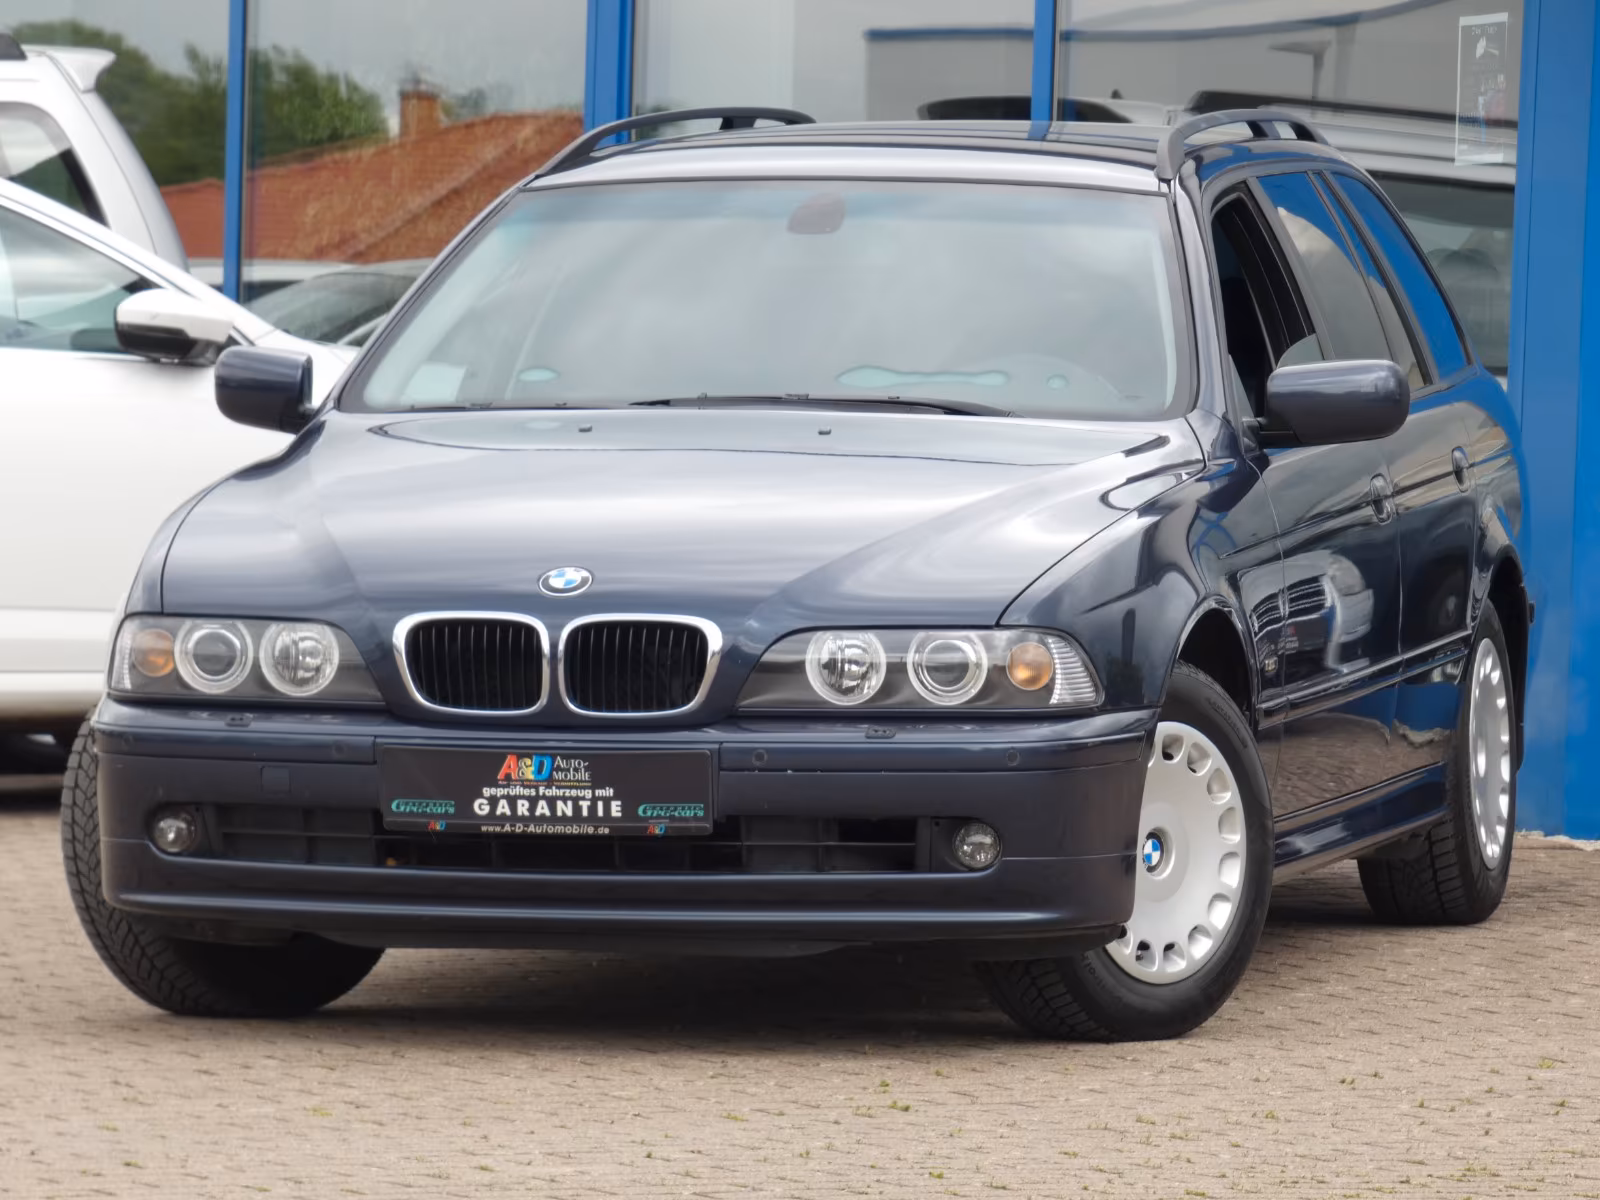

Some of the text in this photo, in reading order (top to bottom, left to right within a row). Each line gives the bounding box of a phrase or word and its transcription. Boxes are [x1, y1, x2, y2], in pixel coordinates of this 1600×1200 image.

[497, 754, 553, 781] A&D
[482, 786, 614, 799] geprüftes Fahrzeug mit
[473, 798, 622, 817] GARANTIE
[481, 823, 610, 834] www.A-D-Automobile.de
